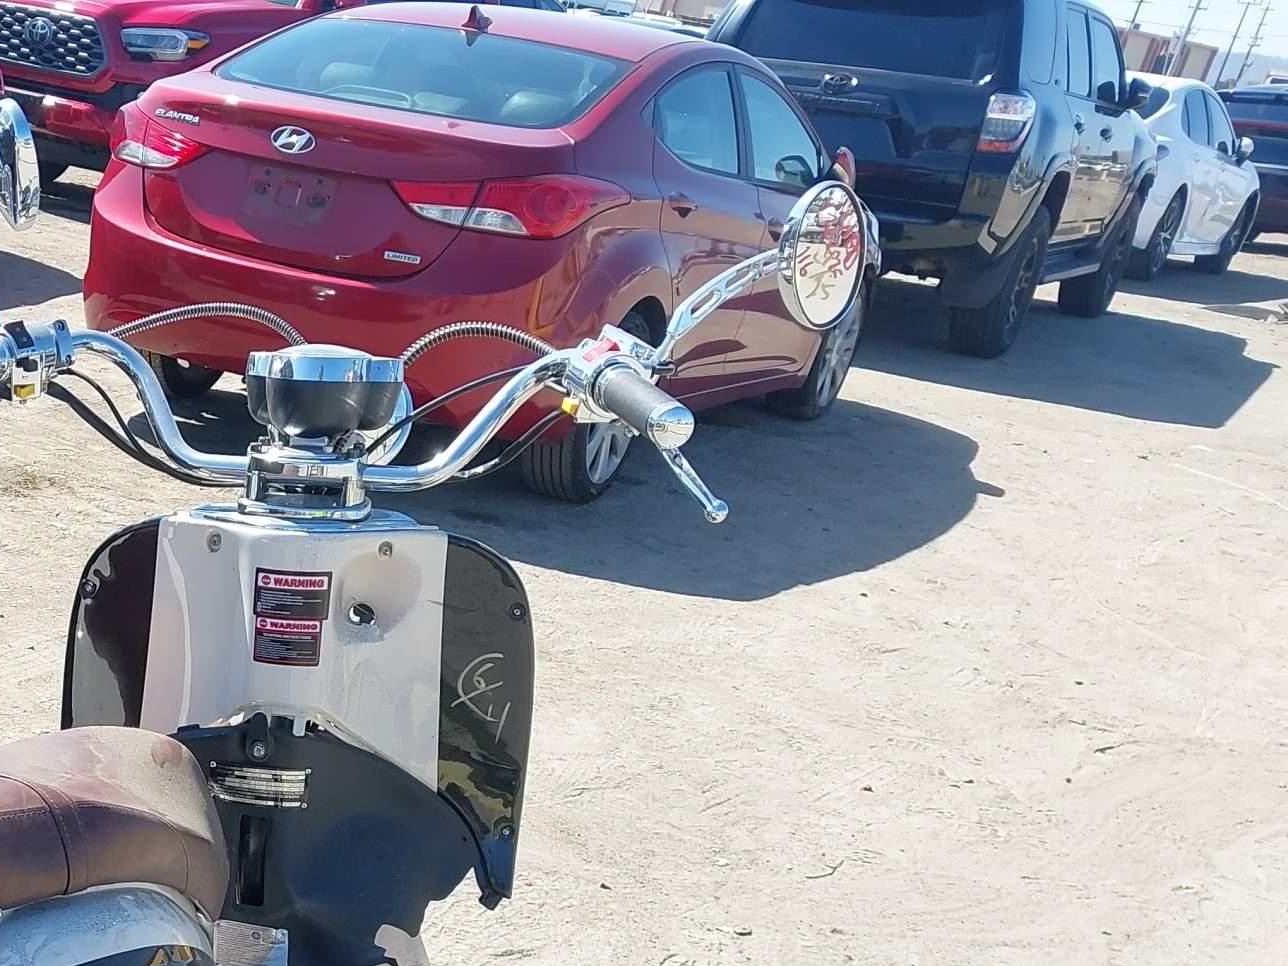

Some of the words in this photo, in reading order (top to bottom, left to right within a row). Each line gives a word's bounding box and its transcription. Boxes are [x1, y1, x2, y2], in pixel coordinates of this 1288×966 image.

[154, 107, 200, 125] ELANTRA
[386, 252, 419, 263] LIMITED
[273, 576, 325, 588] WARNING
[270, 620, 318, 631] WARNING
